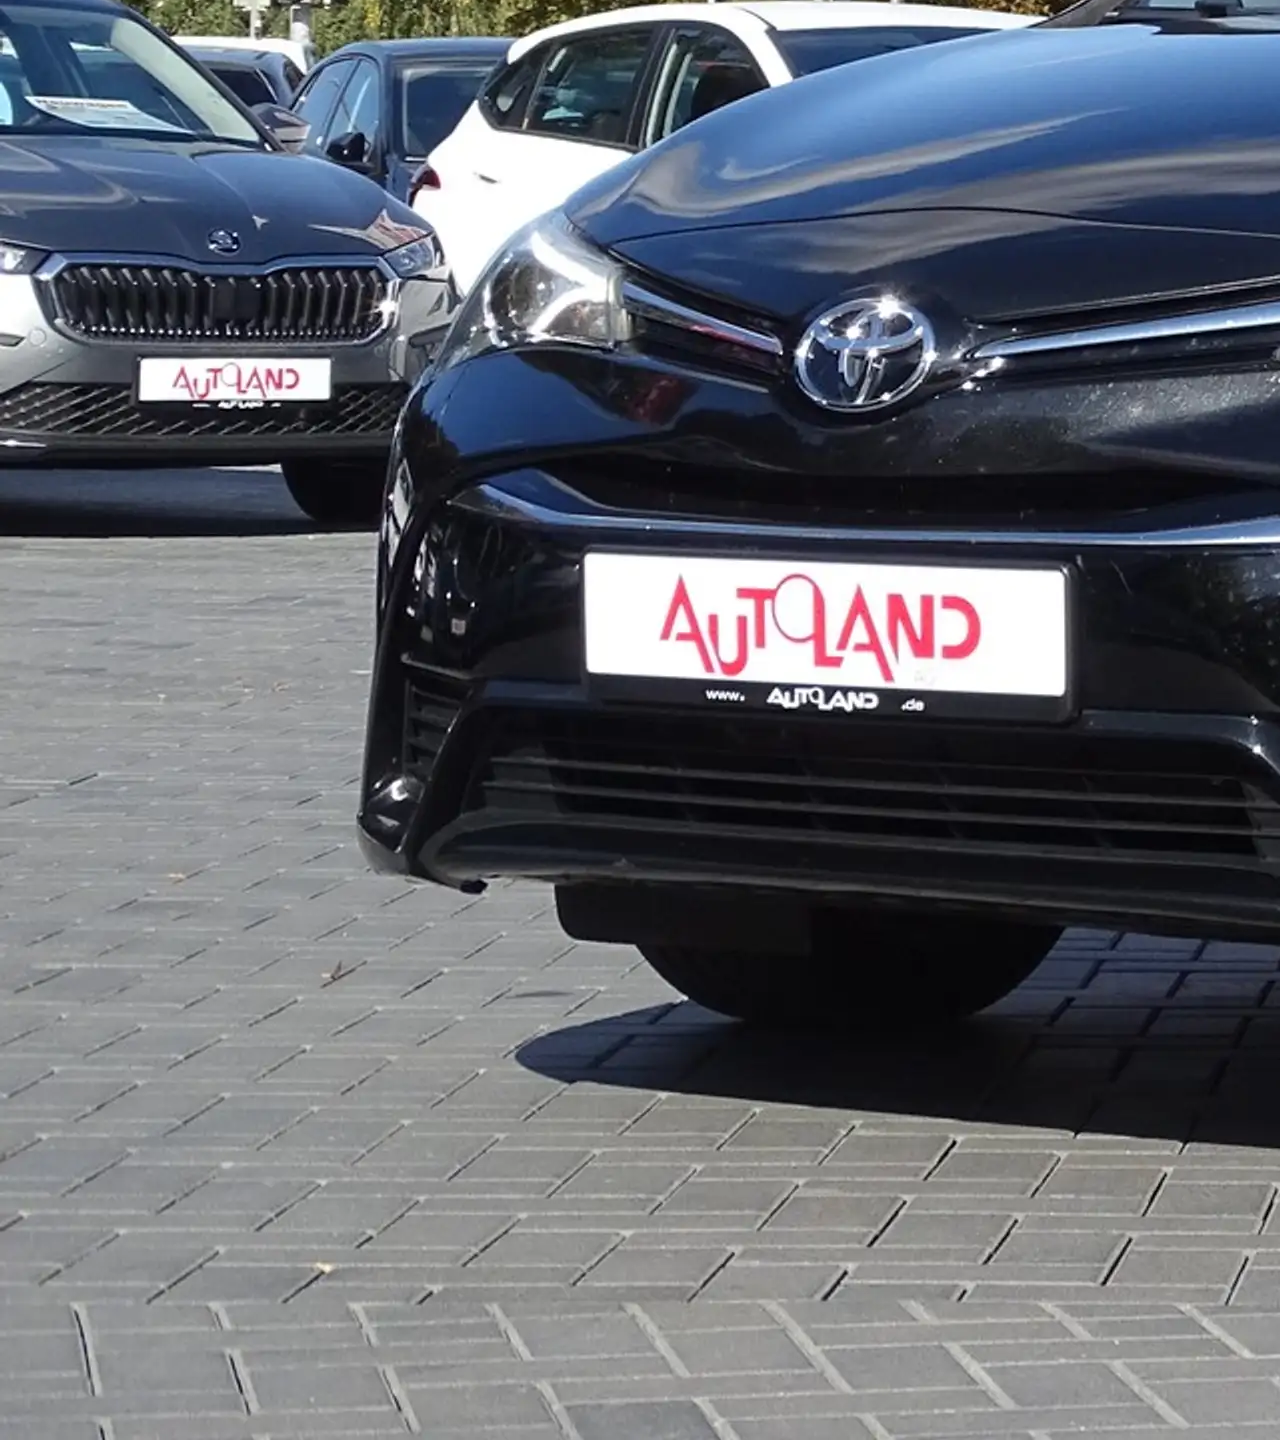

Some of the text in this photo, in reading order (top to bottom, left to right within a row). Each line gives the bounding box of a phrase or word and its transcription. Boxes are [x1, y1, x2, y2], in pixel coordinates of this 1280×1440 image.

[172, 362, 300, 400] AUTOLAND
[660, 573, 982, 683] AUTOLAND
[705, 689, 746, 702] www.
